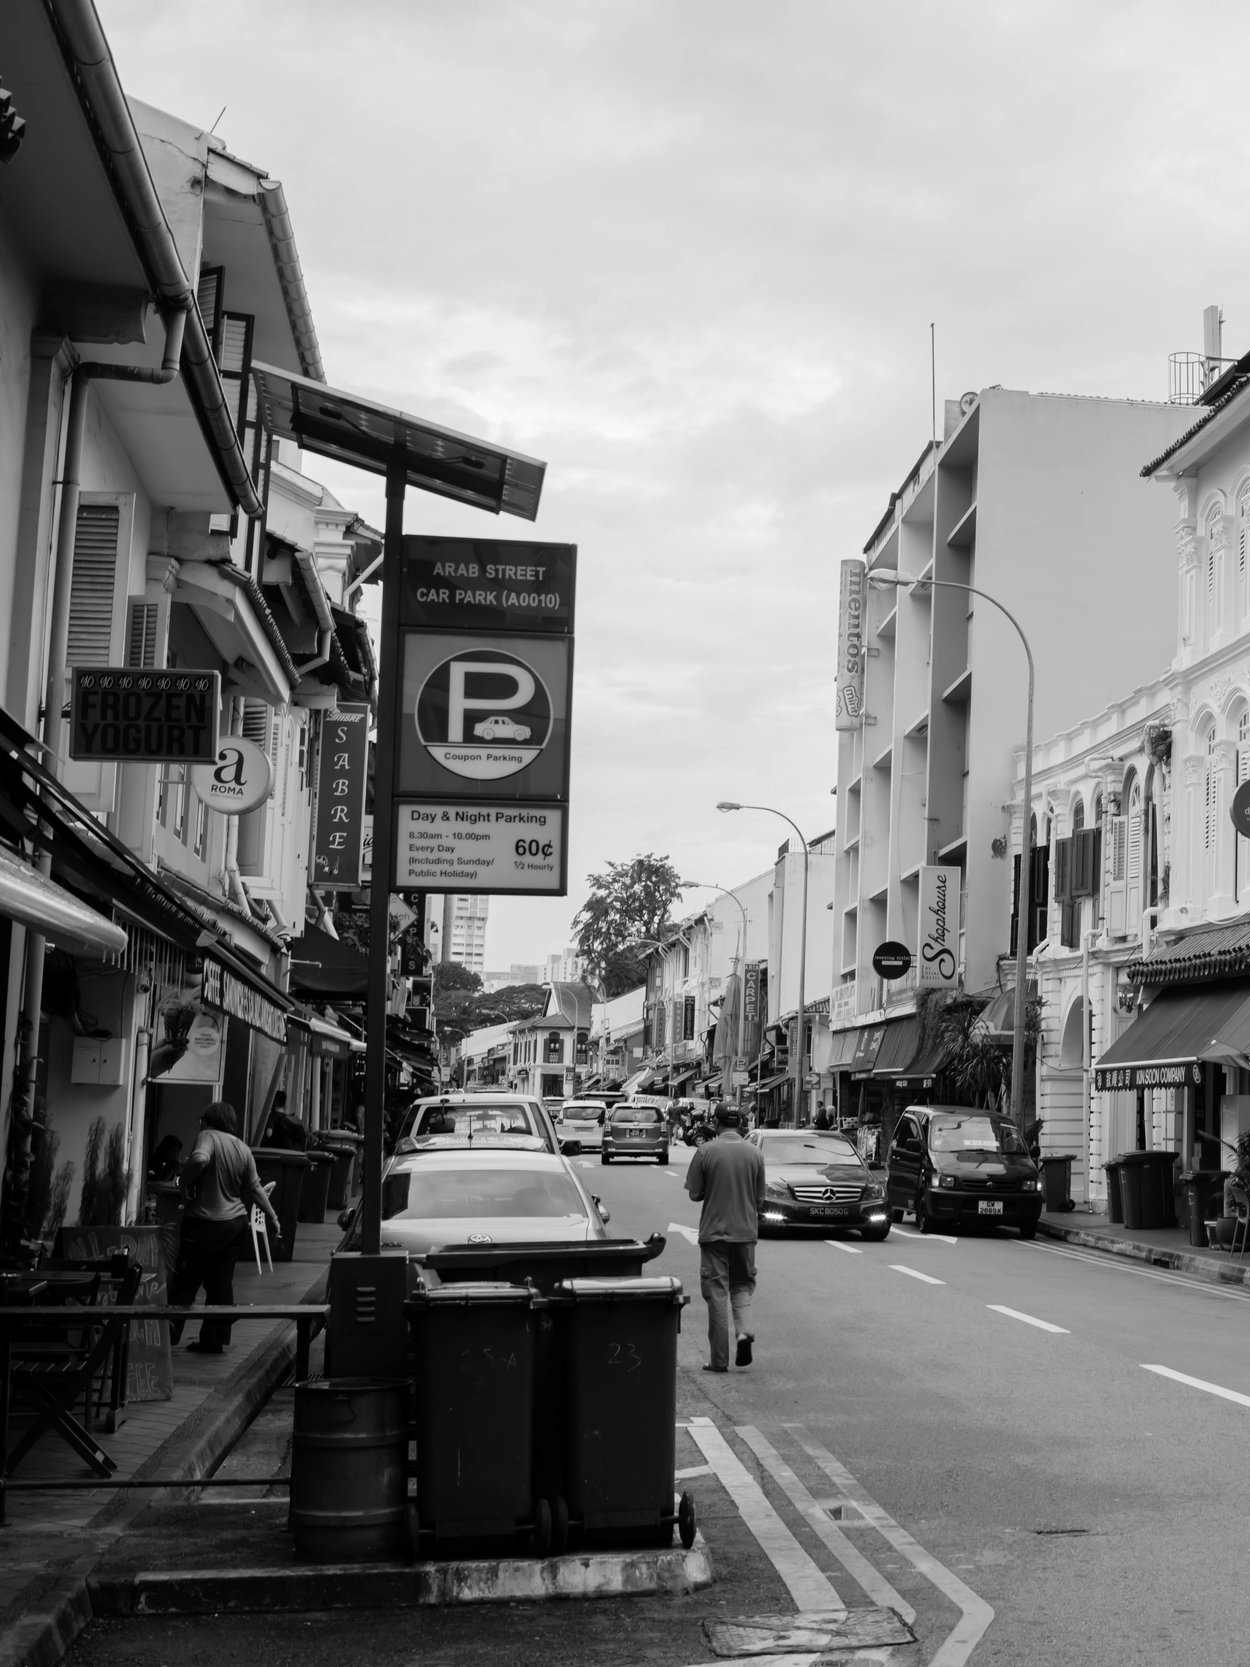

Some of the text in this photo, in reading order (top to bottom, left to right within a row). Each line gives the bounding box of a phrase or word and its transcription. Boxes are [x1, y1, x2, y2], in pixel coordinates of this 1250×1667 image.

[433, 562, 547, 581] ARAB STREET
[416, 587, 561, 610] CAR PARK (A0010)
[847, 568, 862, 674] mentos
[81, 690, 206, 723] FROZEN
[448, 660, 535, 743] P
[79, 722, 207, 755] YOGURT
[213, 748, 248, 786] a
[444, 752, 523, 765] Coupon Parking
[210, 784, 244, 797] ROMA
[329, 727, 350, 849] SABRE
[410, 810, 547, 828] Day & Night Parking
[408, 832, 444, 841] 8.30am
[452, 832, 491, 843] 10.00pm
[408, 844, 456, 856] Every Day
[408, 856, 495, 868] (Including Sunday/
[527, 862, 554, 873] Hourly
[408, 869, 478, 881] Public Holiday)
[922, 874, 955, 980] Shophouse
[745, 971, 757, 1021] CARPET
[1136, 1066, 1186, 1084] KIN SOON COMPANY
